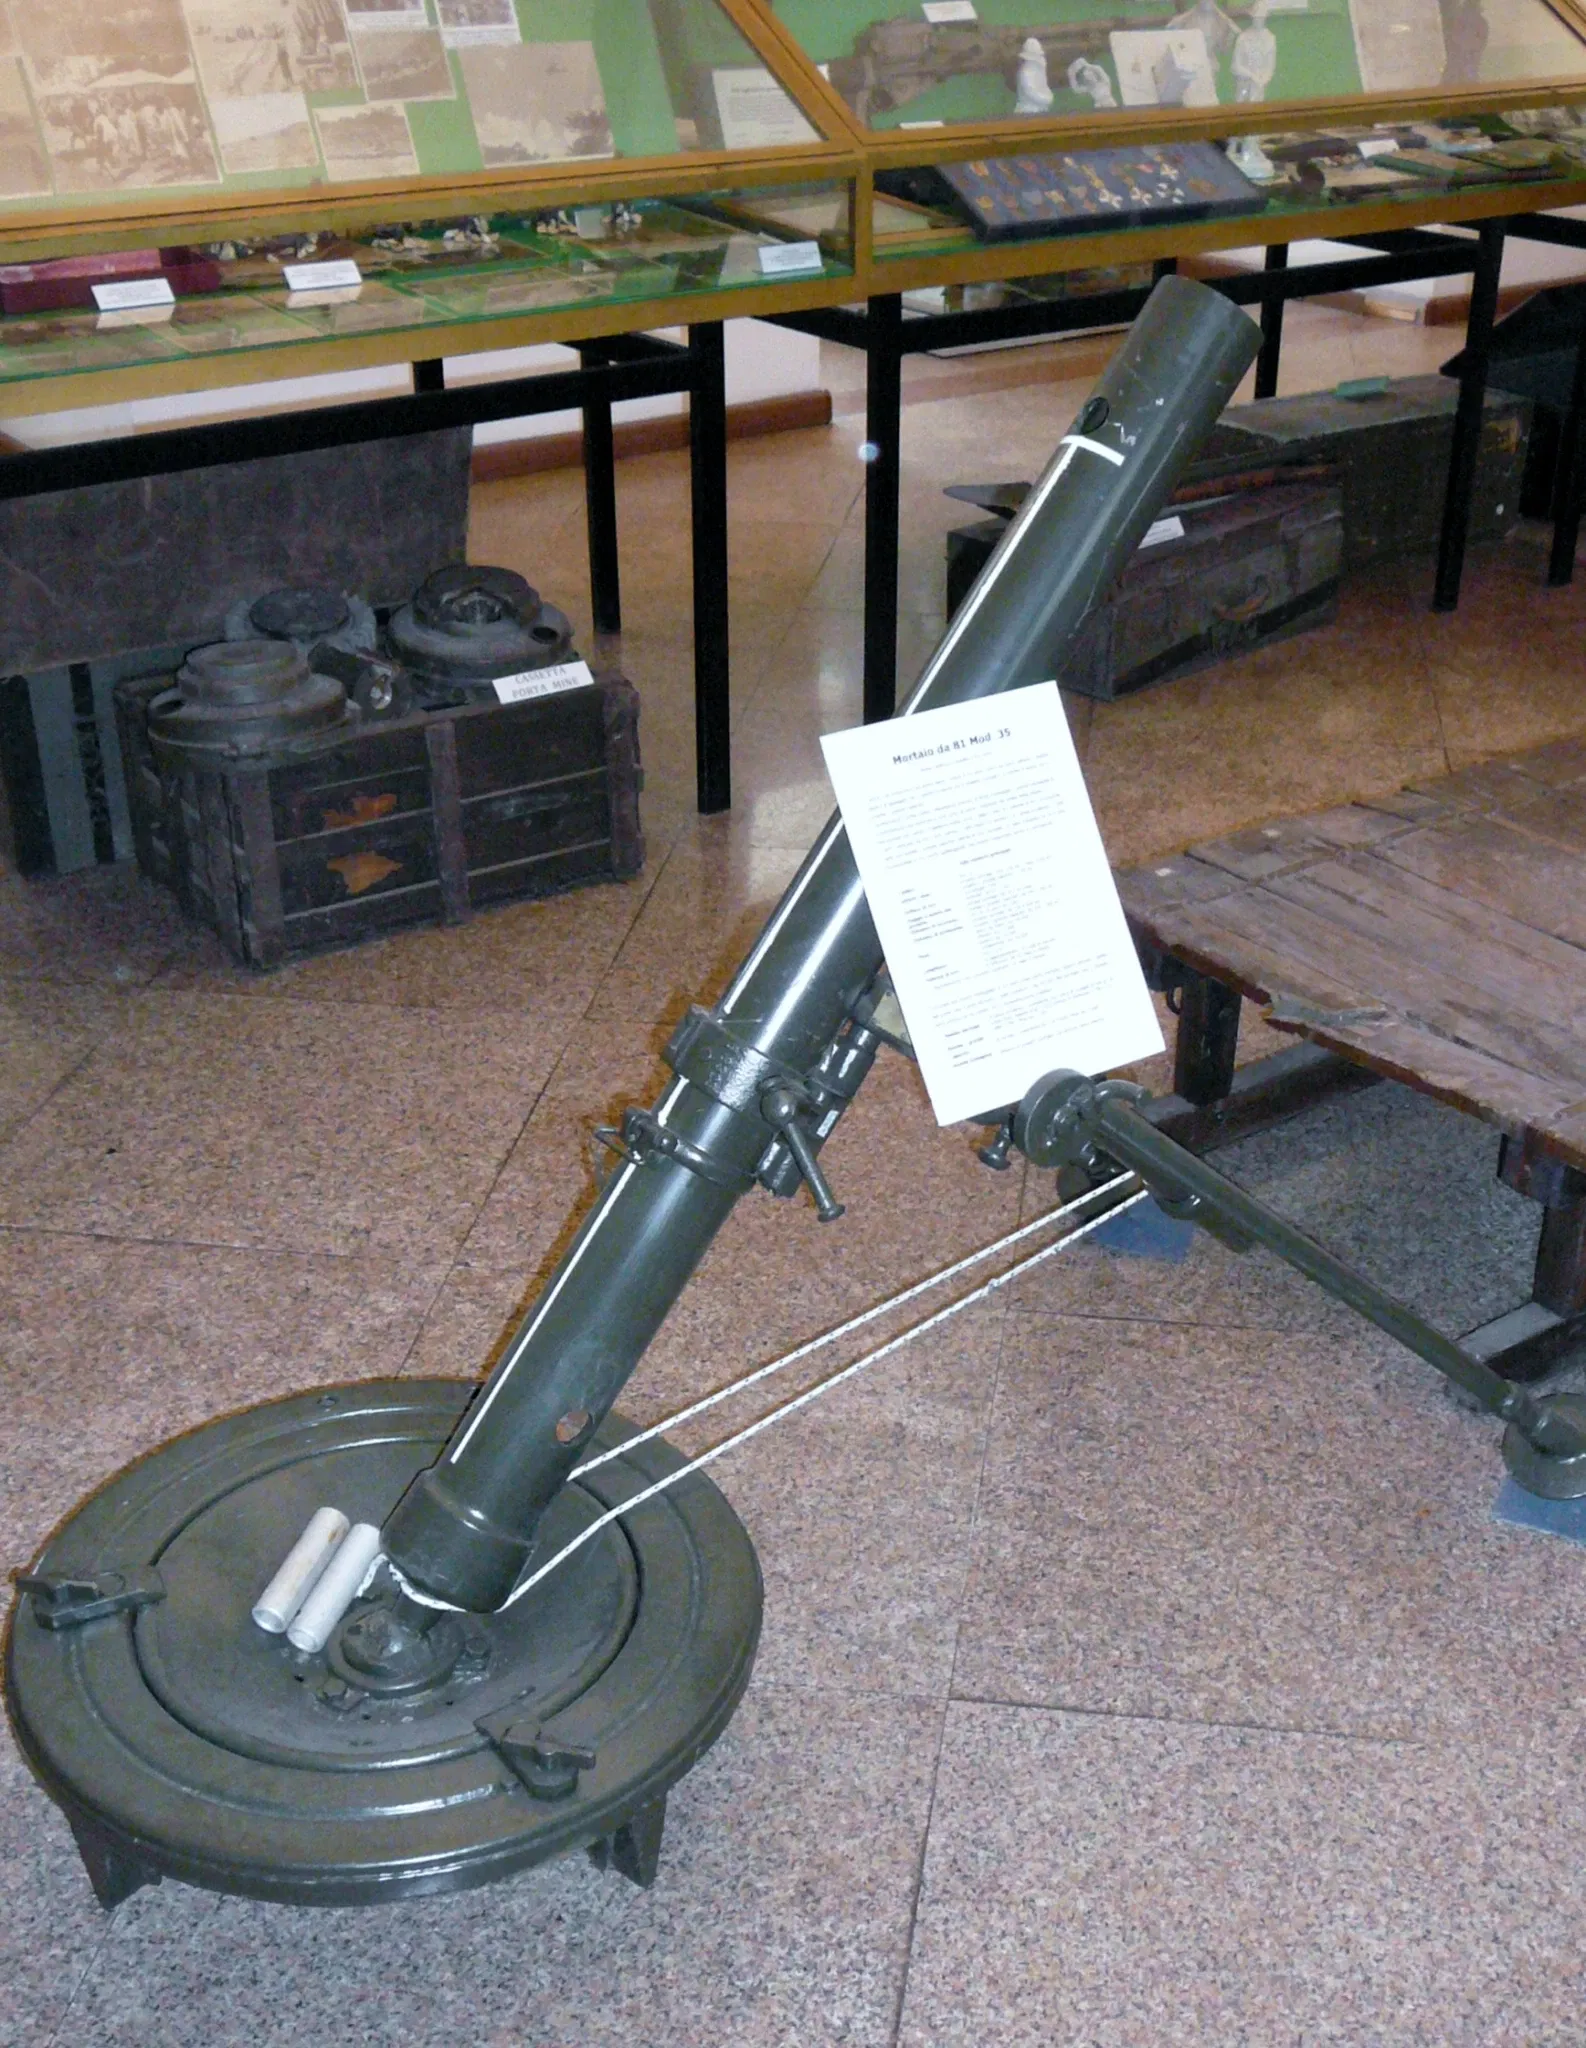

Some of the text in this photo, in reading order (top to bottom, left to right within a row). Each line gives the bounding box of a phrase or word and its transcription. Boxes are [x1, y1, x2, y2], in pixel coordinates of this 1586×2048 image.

[512, 677, 579, 699] PORTA MINE
[892, 748, 934, 765] Mortaio
[937, 743, 950, 754] da
[953, 739, 966, 750] 81
[998, 728, 1011, 739] 35
